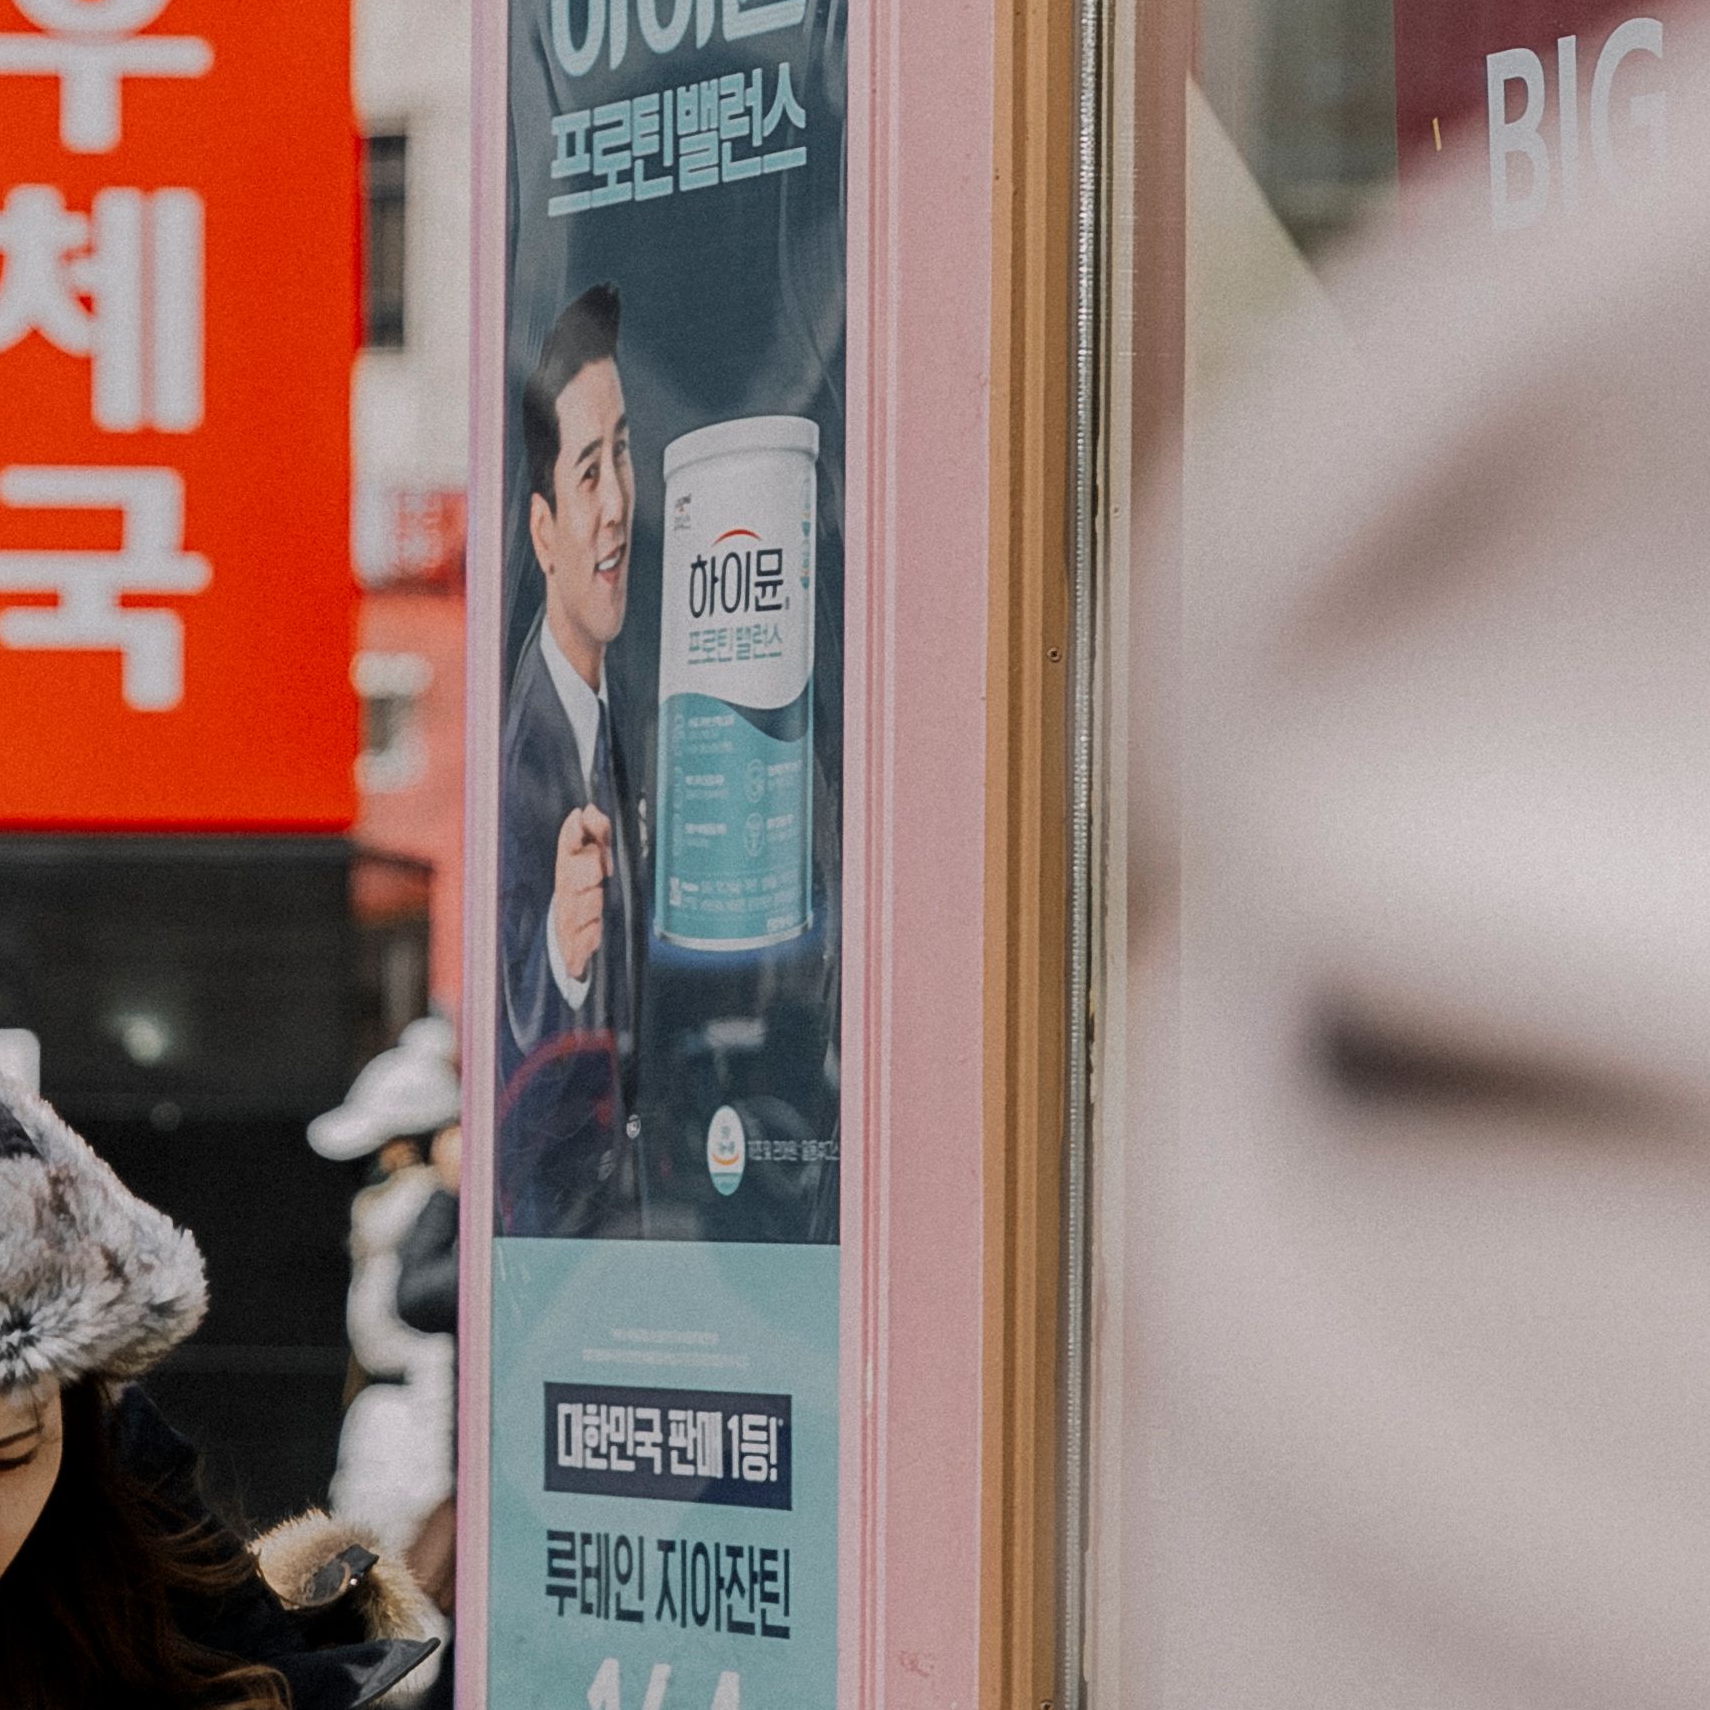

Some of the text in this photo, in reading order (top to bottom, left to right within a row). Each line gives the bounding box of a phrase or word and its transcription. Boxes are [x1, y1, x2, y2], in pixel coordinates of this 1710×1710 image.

[1486, 17, 1665, 232] BIG
[690, 548, 784, 619] 하이뮨
[556, 1402, 664, 1476] 대한민국
[667, 1409, 724, 1480] 판매
[545, 1529, 791, 1640] 루테인 지아잔틴
